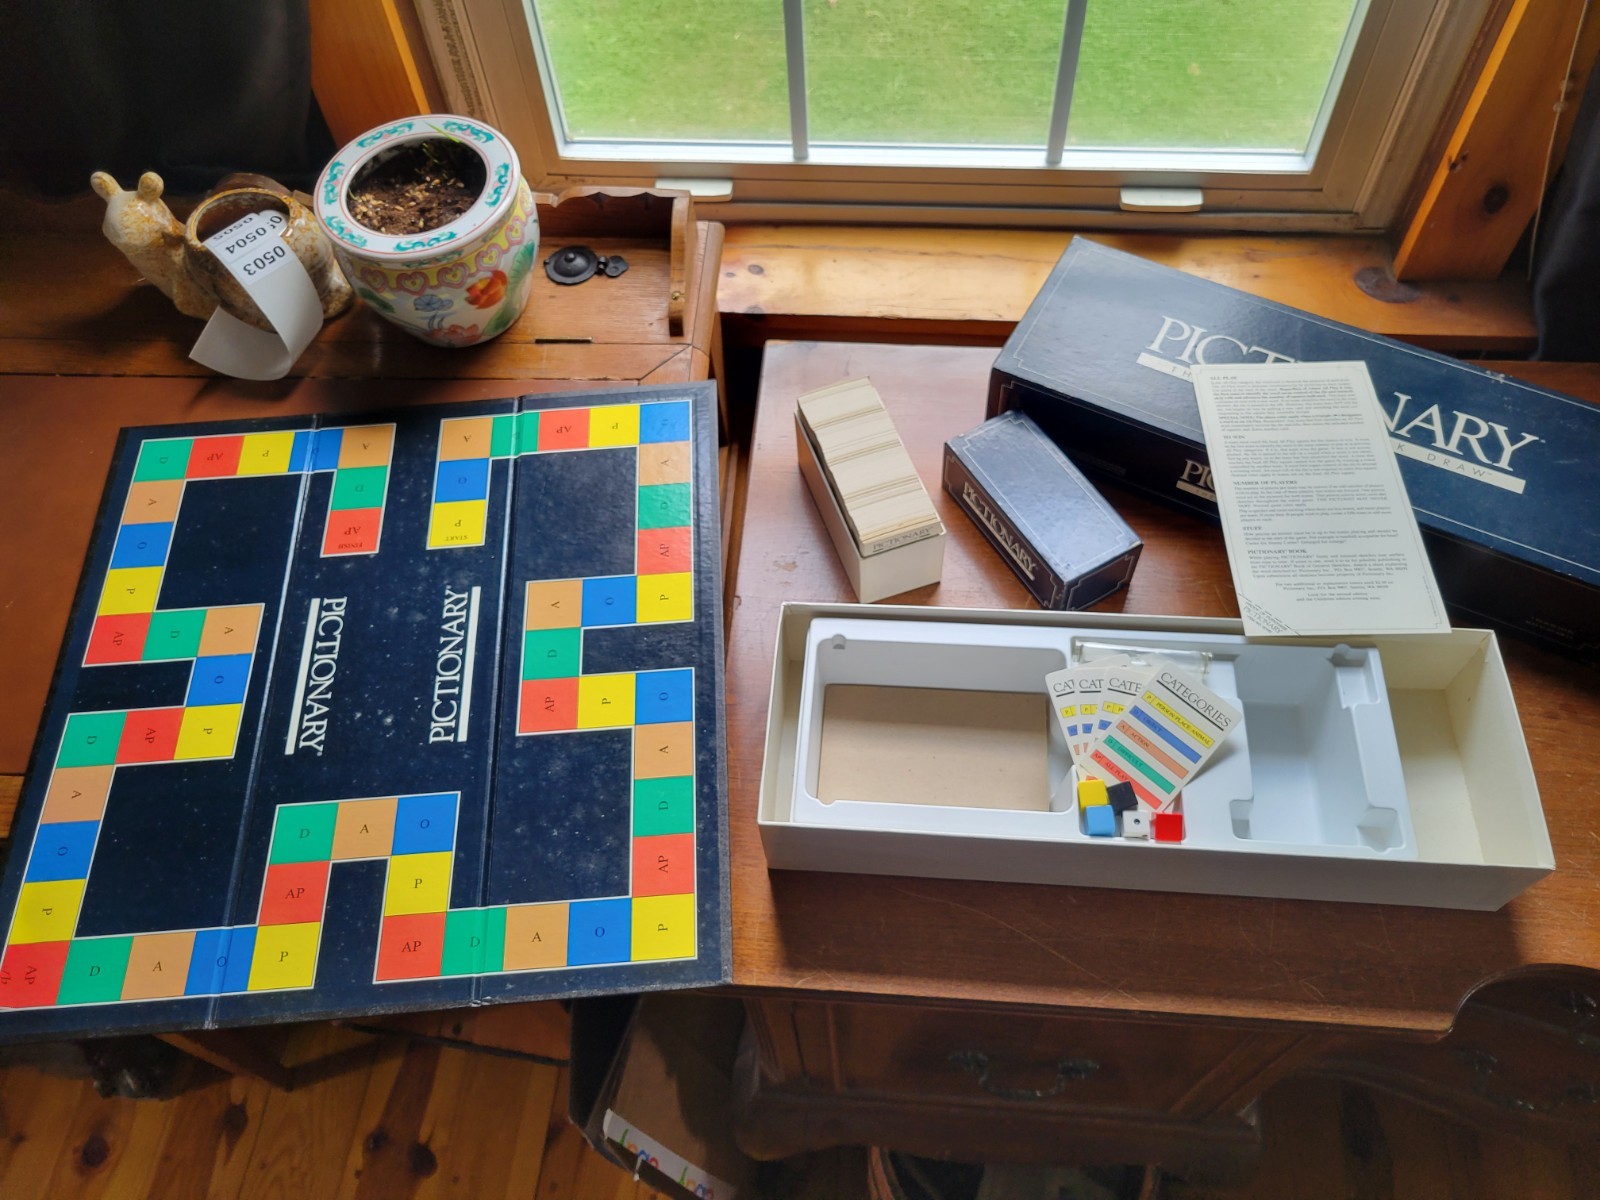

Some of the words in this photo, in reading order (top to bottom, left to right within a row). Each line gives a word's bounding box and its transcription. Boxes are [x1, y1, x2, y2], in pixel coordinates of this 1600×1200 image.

[225, 226, 267, 254] 0504
[243, 245, 286, 276] 0503
[1426, 452, 1487, 477] DRAW
[964, 481, 1036, 571] PICTIONARY
[299, 596, 347, 753] PICTIONARY
[428, 588, 469, 744] PICTIONARY
[1160, 671, 1231, 727] CATEGORIES
